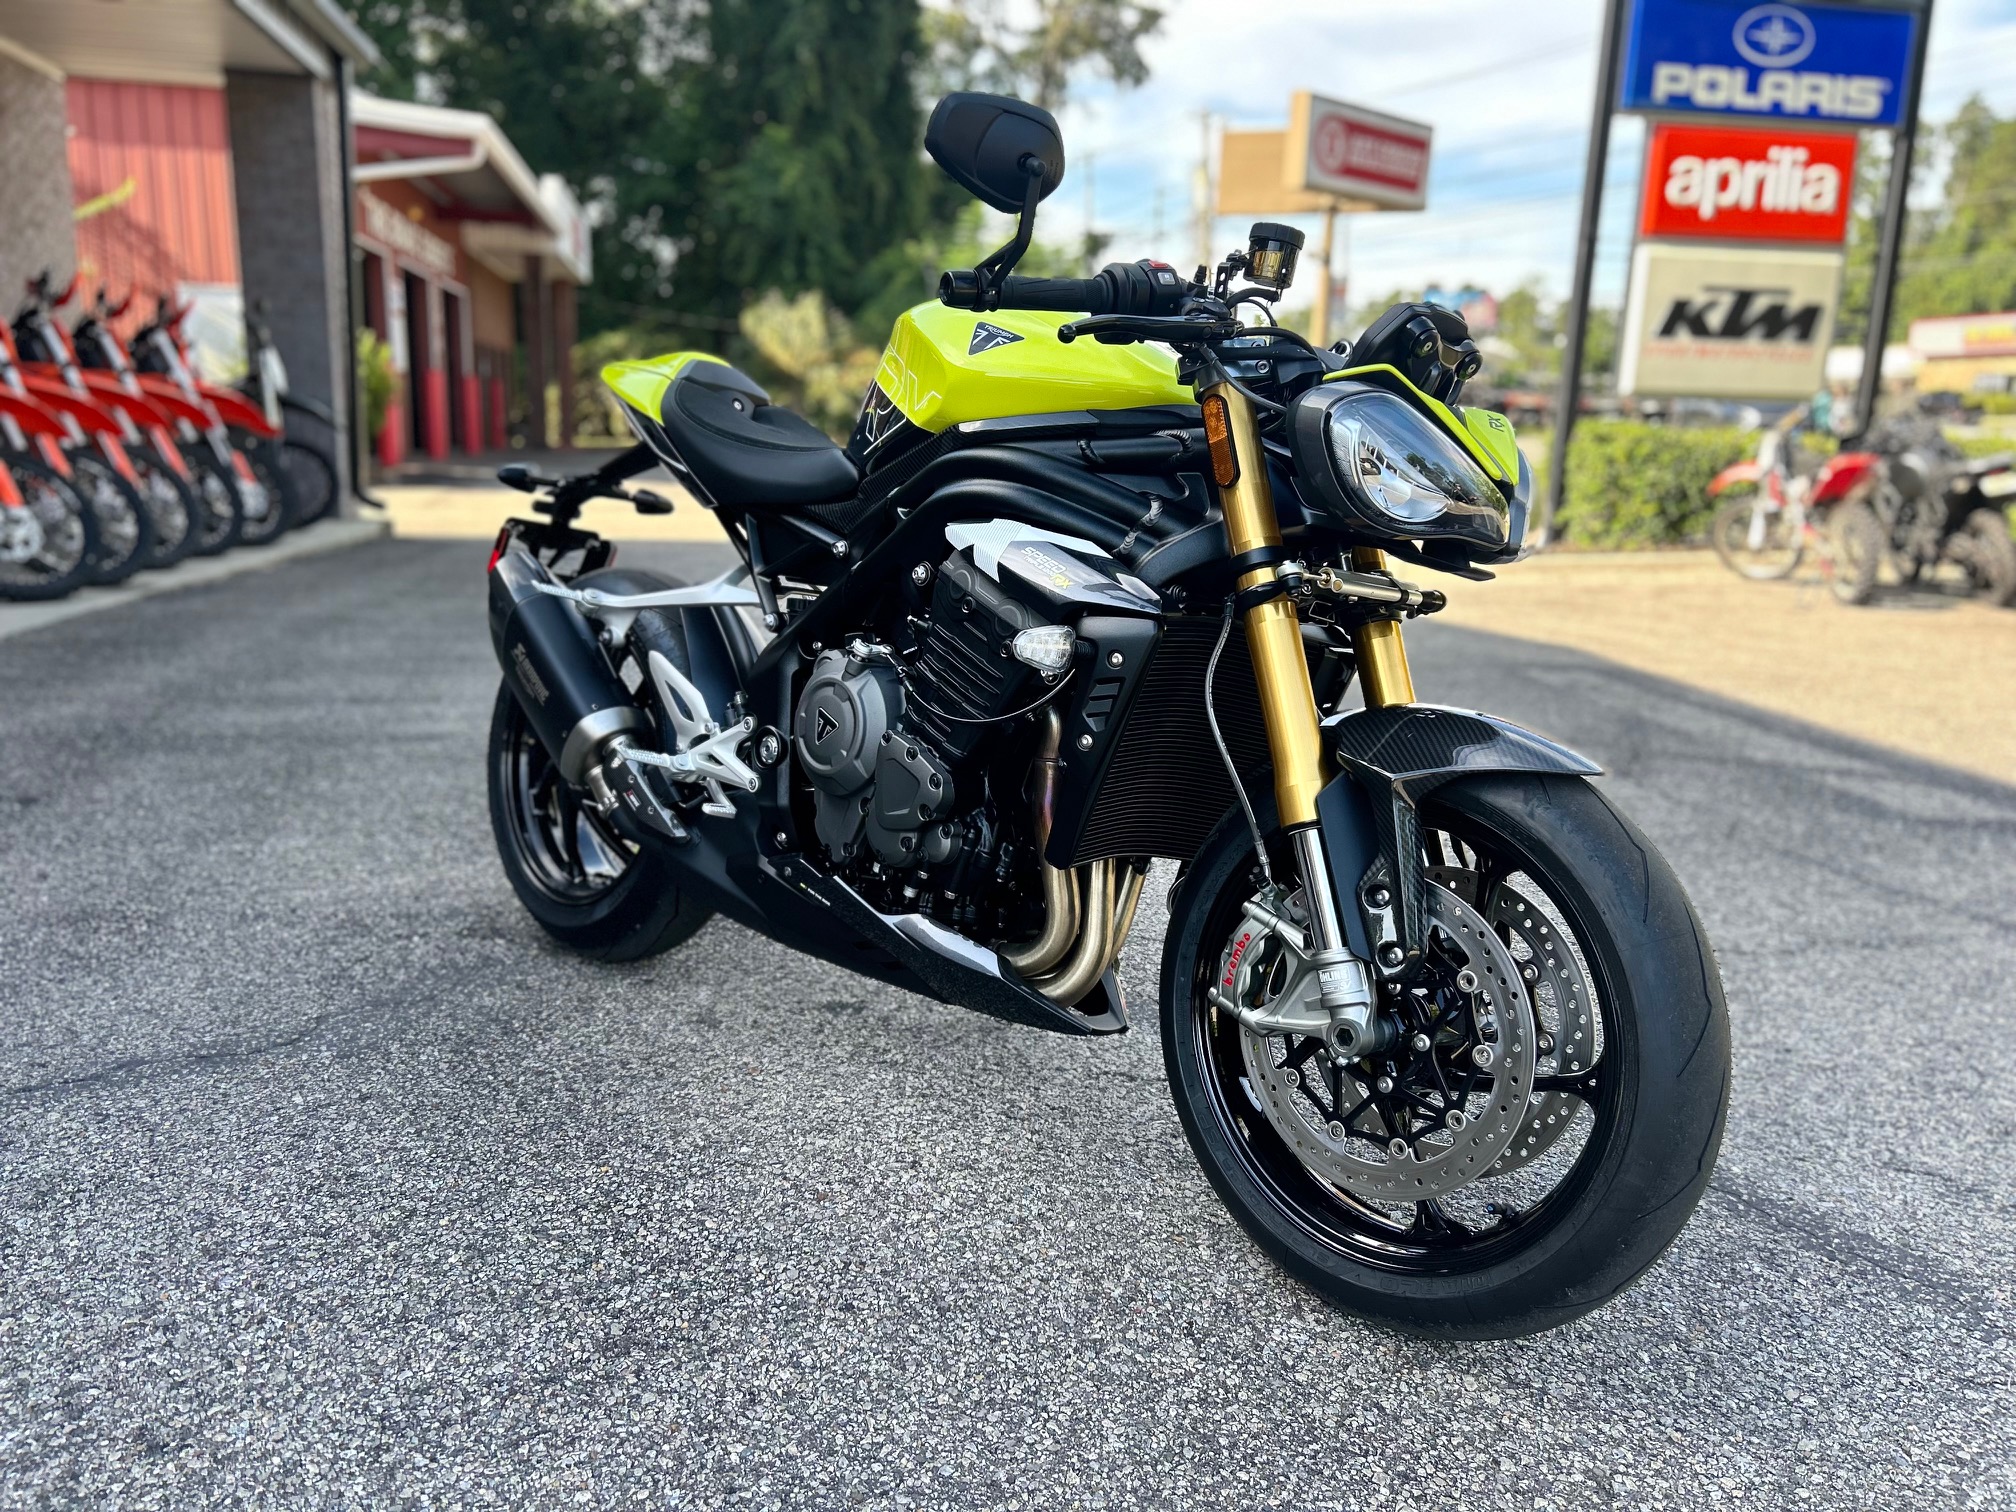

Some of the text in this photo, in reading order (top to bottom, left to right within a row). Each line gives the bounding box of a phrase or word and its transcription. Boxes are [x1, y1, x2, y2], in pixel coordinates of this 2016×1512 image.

[1653, 61, 1887, 119] POLARIS
[1664, 145, 1841, 221] aprilia
[984, 324, 1015, 339] TRIUMPH
[1658, 284, 1823, 343] KTM
[1020, 546, 1067, 574] SPEED
[1222, 932, 1251, 987] brembo
